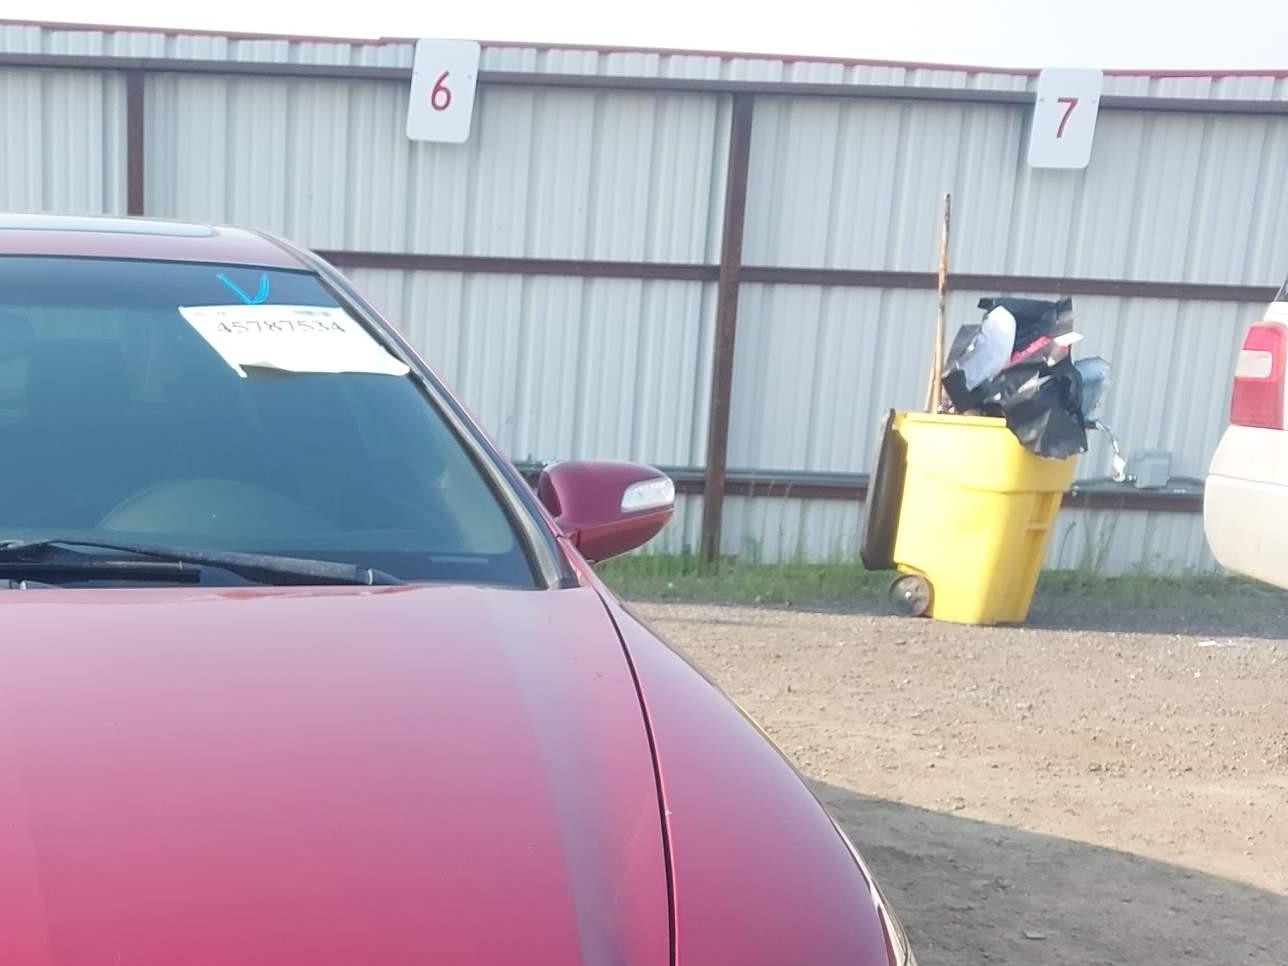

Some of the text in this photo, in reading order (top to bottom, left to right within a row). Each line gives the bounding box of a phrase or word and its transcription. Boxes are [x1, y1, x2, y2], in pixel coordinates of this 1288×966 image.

[431, 70, 451, 111] 6
[1056, 97, 1079, 139] 7
[216, 319, 347, 335] 45787534
